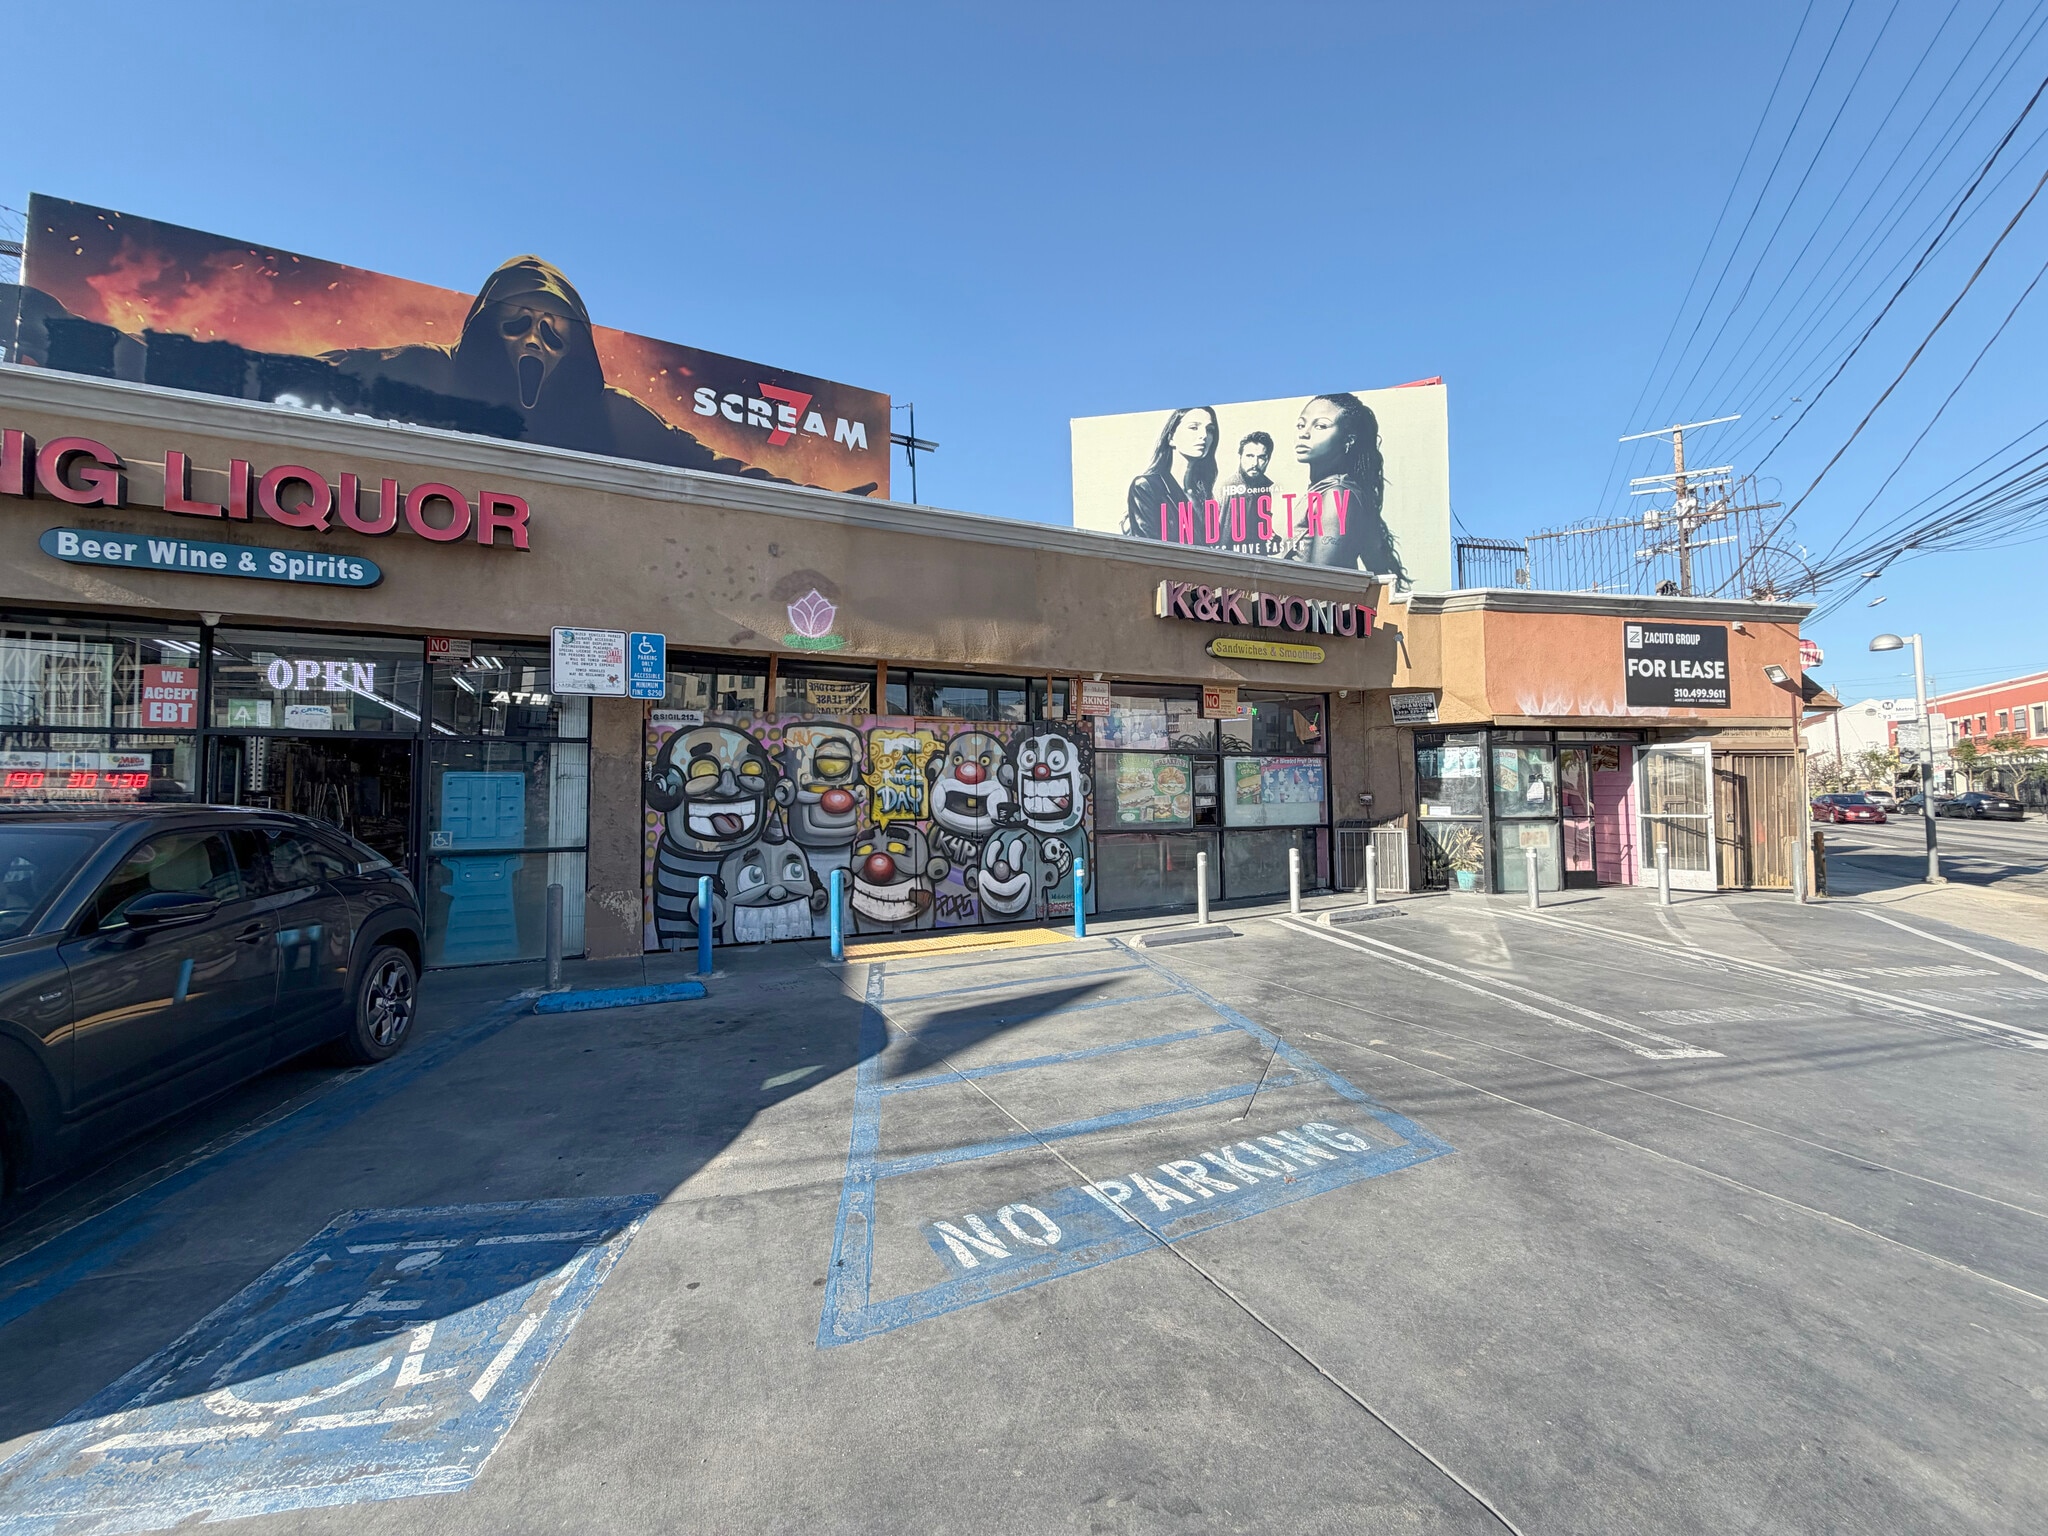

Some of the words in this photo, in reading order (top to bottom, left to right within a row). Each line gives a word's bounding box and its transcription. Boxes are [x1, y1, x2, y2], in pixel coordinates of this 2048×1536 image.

[693, 387, 868, 452] SCREAM
[758, 382, 813, 446] 7
[1223, 485, 1246, 496] HBO
[1247, 486, 1284, 494] ORIGINAL
[164, 450, 531, 551] LIQUOR
[1160, 489, 1350, 545] INDUSTRY
[58, 531, 138, 561] Beer
[147, 539, 228, 570] Wine
[238, 551, 257, 572] &
[268, 551, 364, 580] Spirits
[1233, 543, 1260, 554] MOVE
[1266, 541, 1305, 553] FASTER
[1164, 580, 1249, 625] K&K
[1254, 591, 1377, 638] DONUT
[431, 639, 449, 652] NO
[1645, 632, 1674, 645] ZACUTO
[1675, 633, 1701, 645] GROUP
[1216, 641, 1268, 657] Sandwiches
[1270, 646, 1277, 657] &
[1279, 647, 1322, 660] Smoothies
[161, 670, 184, 683] WE
[267, 659, 377, 692] OPEN
[1628, 658, 1667, 678] FOR
[1671, 660, 1725, 679] LEASE
[144, 687, 199, 700] ACCEPT
[491, 690, 552, 706] ATM
[1071, 695, 1109, 705] PRKING
[1206, 695, 1219, 707] NO
[1674, 688, 1726, 699] 310.499.9611
[149, 702, 193, 723] EBT
[300, 707, 329, 715] CAMEL
[4, 772, 45, 788] 190
[67, 773, 99, 788] 30
[104, 773, 149, 788] 438
[876, 785, 924, 815] DAY
[932, 1202, 1063, 1269] NO
[1080, 1121, 1371, 1223] PARKING
